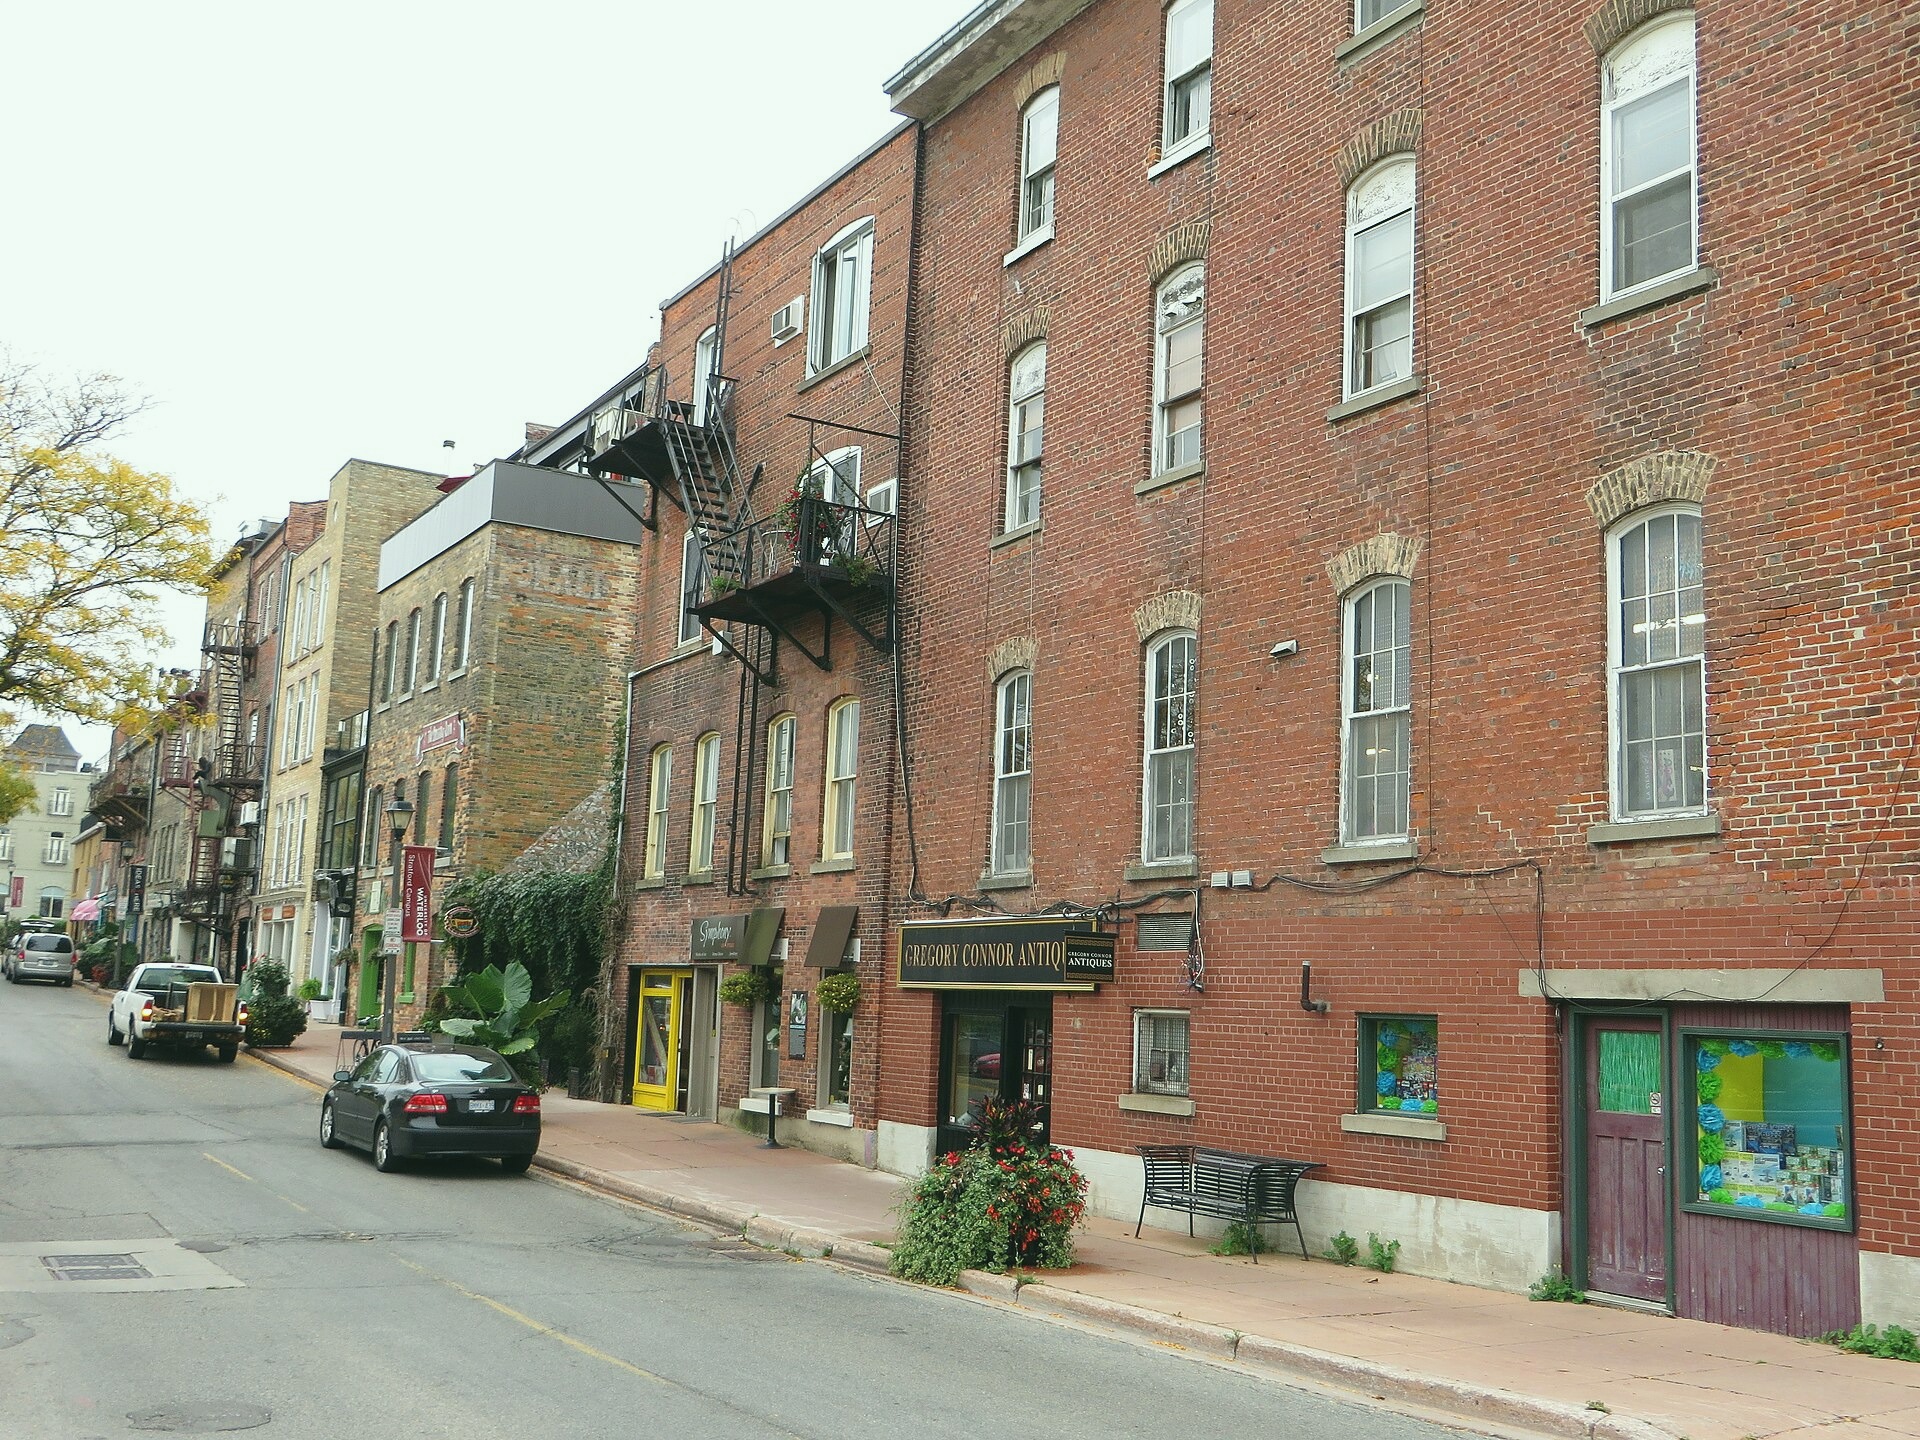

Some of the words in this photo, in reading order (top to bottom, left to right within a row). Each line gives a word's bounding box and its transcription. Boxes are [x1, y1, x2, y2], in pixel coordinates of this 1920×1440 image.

[406, 854, 416, 886] Stratford
[404, 887, 413, 917] Campus
[416, 887, 424, 936] WATERLOO
[700, 920, 732, 948] Symphony
[905, 943, 960, 967] GREGORY
[962, 942, 1015, 967] CONNOR
[1068, 957, 1113, 969] ANTIQUES
